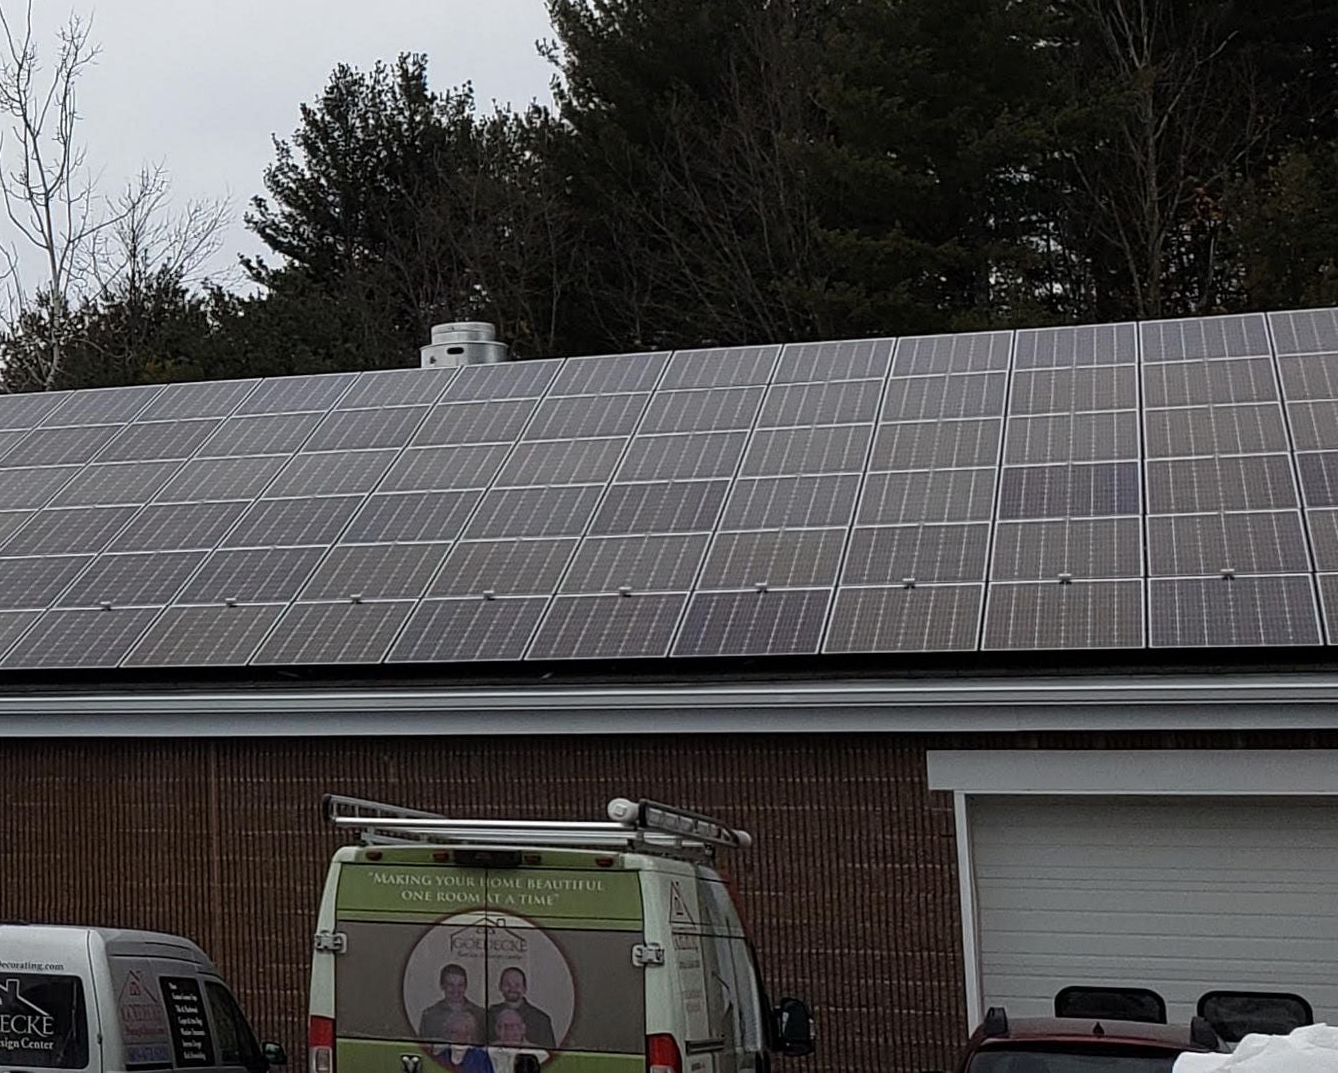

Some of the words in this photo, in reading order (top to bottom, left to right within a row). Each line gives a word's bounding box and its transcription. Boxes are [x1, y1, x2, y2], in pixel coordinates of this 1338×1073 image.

[435, 876, 476, 887] YOUR
[527, 878, 604, 891] BEAUTIFUL
[401, 890, 432, 901] ONE
[436, 891, 480, 903] ROOM
[505, 894, 516, 904] A
[21, 1037, 55, 1050] Center
